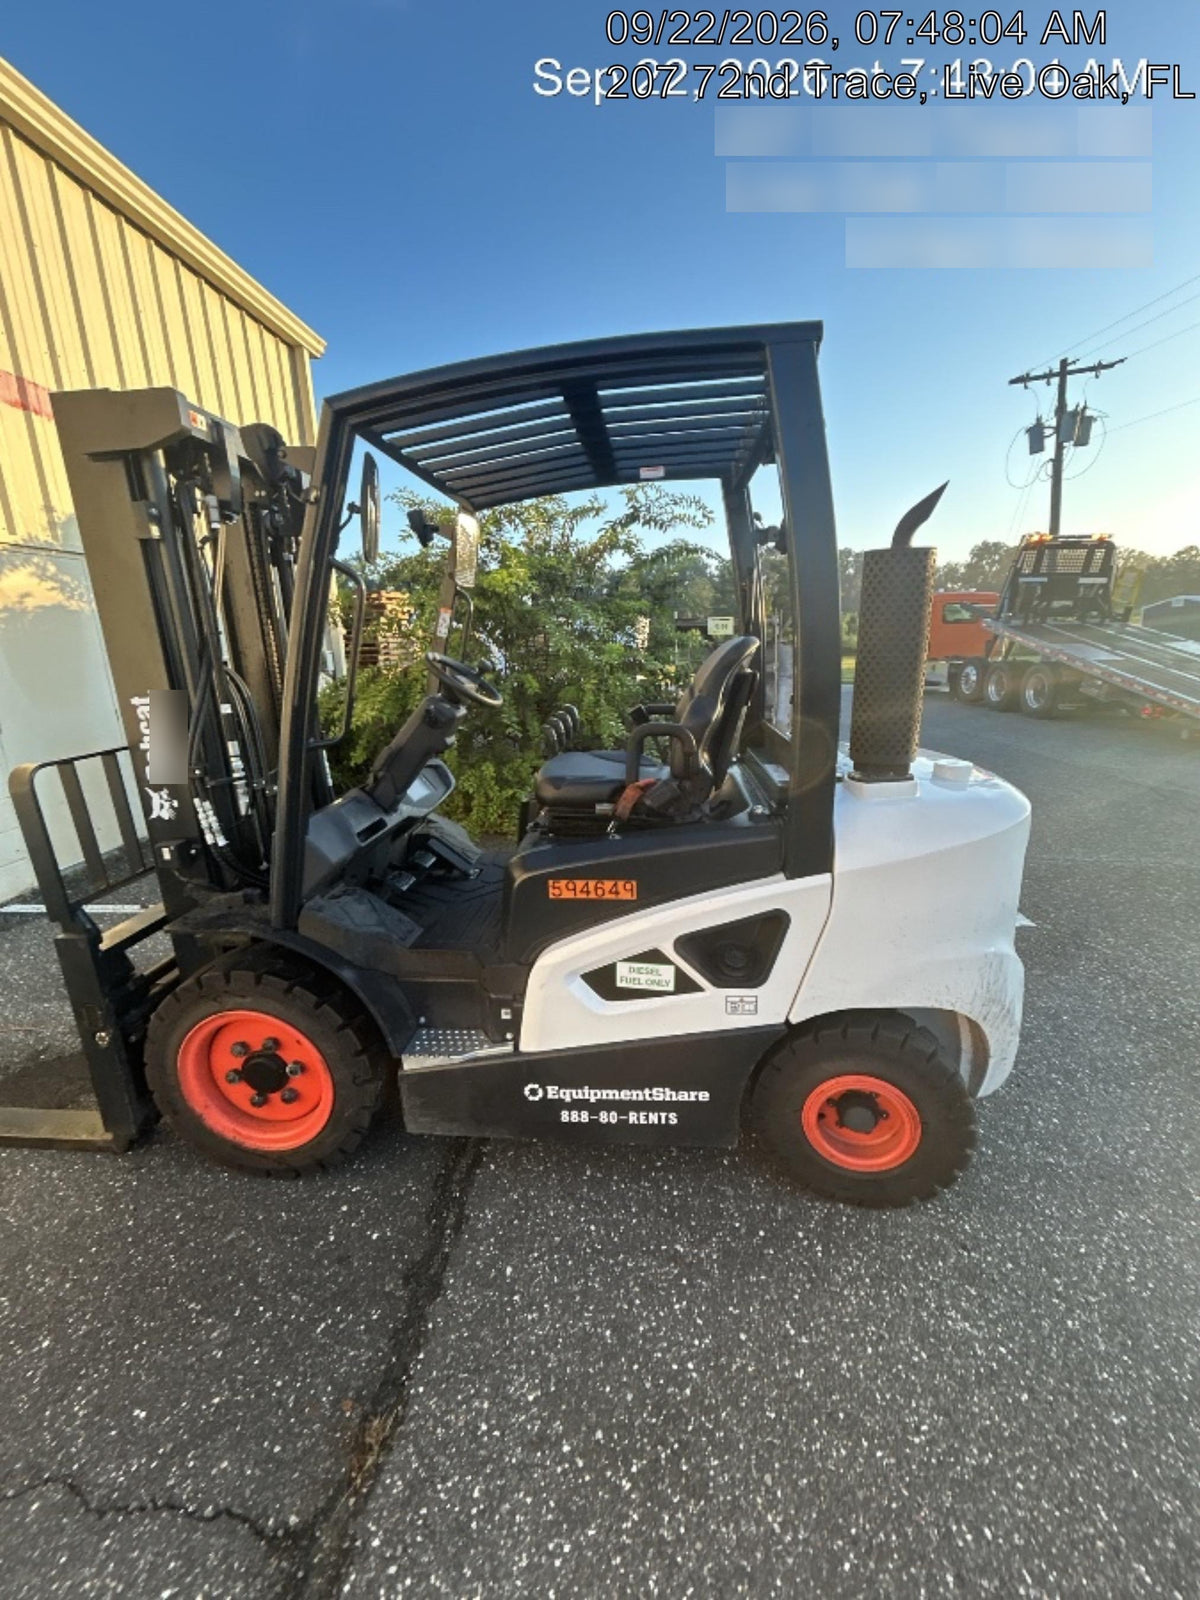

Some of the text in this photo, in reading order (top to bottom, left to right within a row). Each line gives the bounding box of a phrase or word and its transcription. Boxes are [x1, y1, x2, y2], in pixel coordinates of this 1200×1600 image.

[551, 880, 635, 898] 594649
[628, 965, 662, 977] DIESEL
[620, 976, 671, 988] FUEL ONLY
[545, 1085, 711, 1103] EquipmentShare
[560, 1110, 679, 1125] 888-80-RENTS
